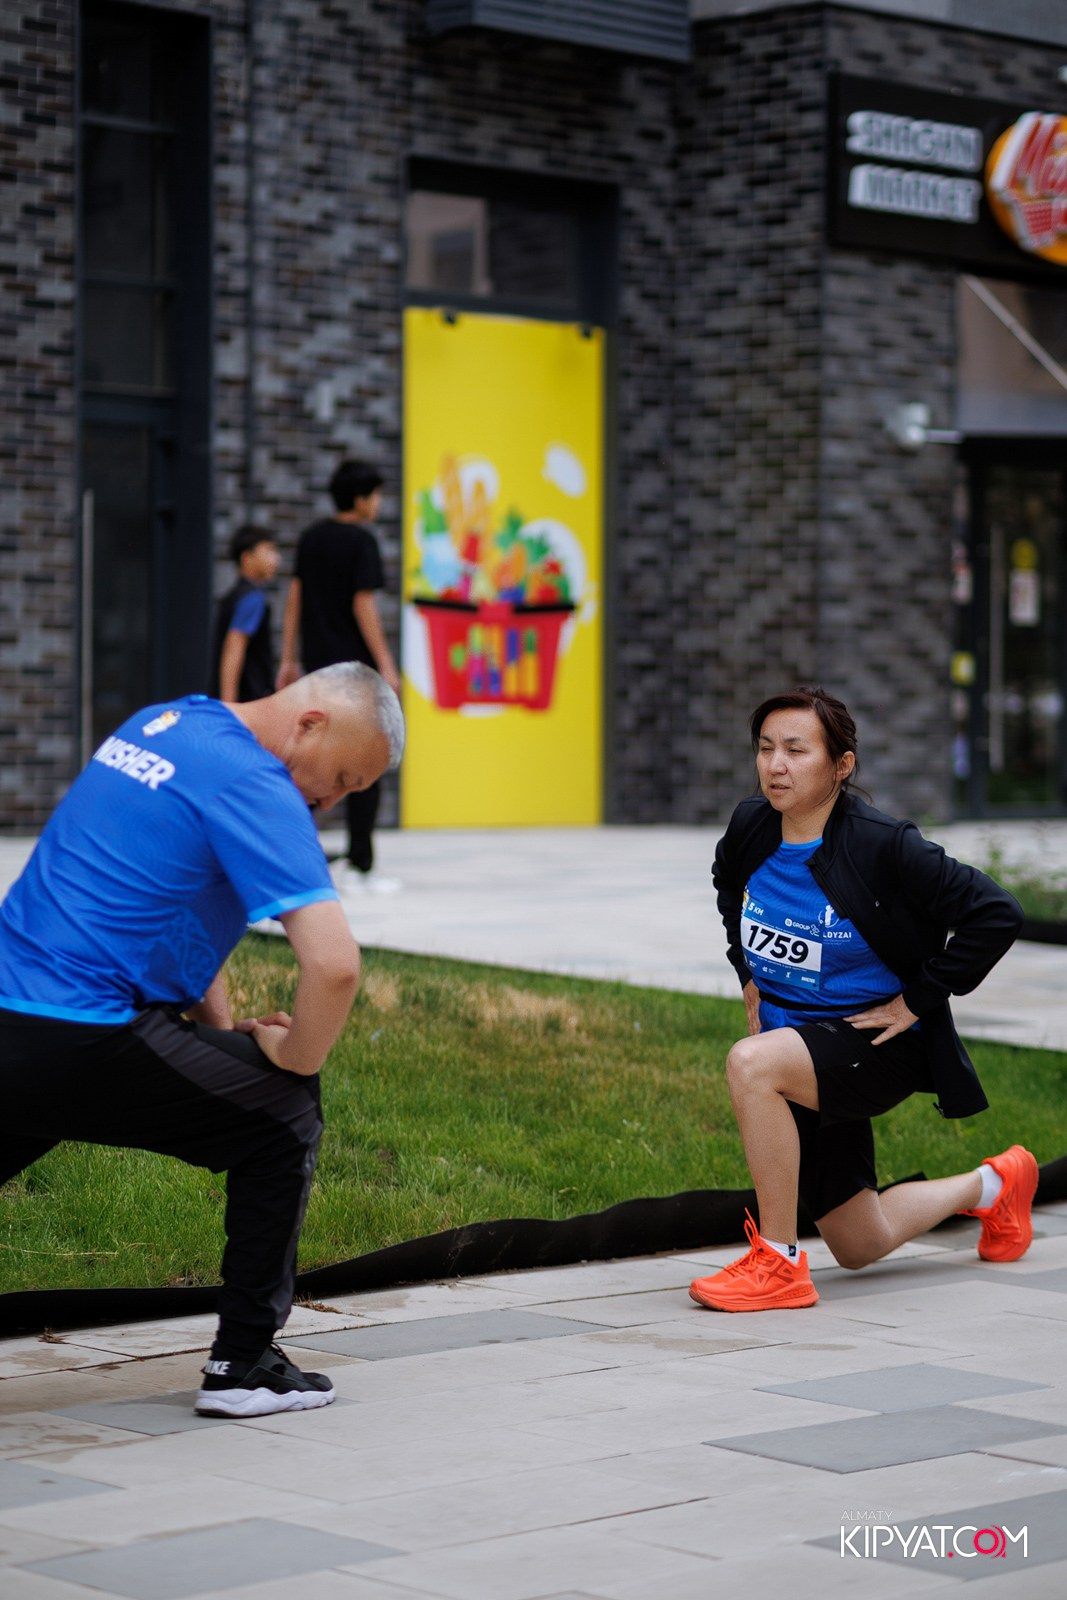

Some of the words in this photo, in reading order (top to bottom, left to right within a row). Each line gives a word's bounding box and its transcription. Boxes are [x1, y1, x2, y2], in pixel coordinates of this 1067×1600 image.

[848, 163, 982, 224] MARKET
[748, 902, 755, 911] 5
[753, 906, 764, 916] KM
[792, 921, 811, 931] GROUP
[747, 925, 809, 964] 1759
